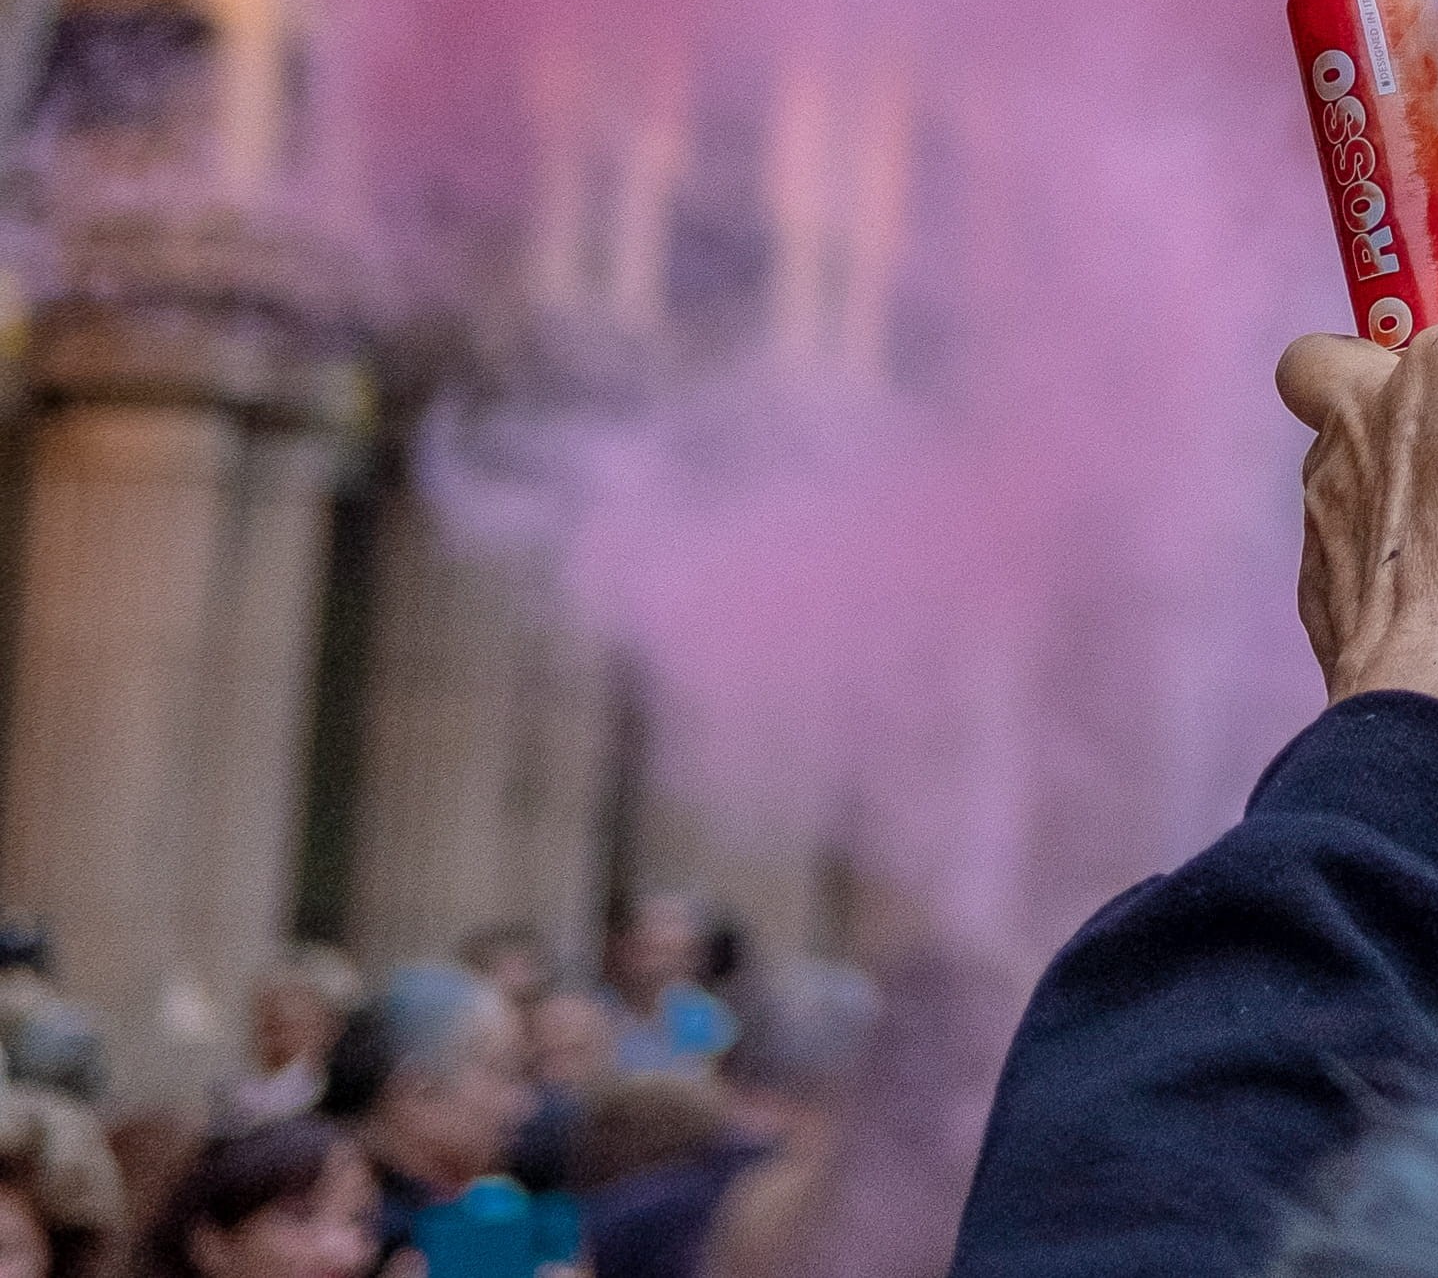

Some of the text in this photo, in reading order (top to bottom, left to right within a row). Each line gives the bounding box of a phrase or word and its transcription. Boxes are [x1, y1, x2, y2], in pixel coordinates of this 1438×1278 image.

[1364, 11, 1378, 24] IN
[1370, 28, 1390, 80] DESIGNED
[1312, 49, 1400, 282] ROSSO
